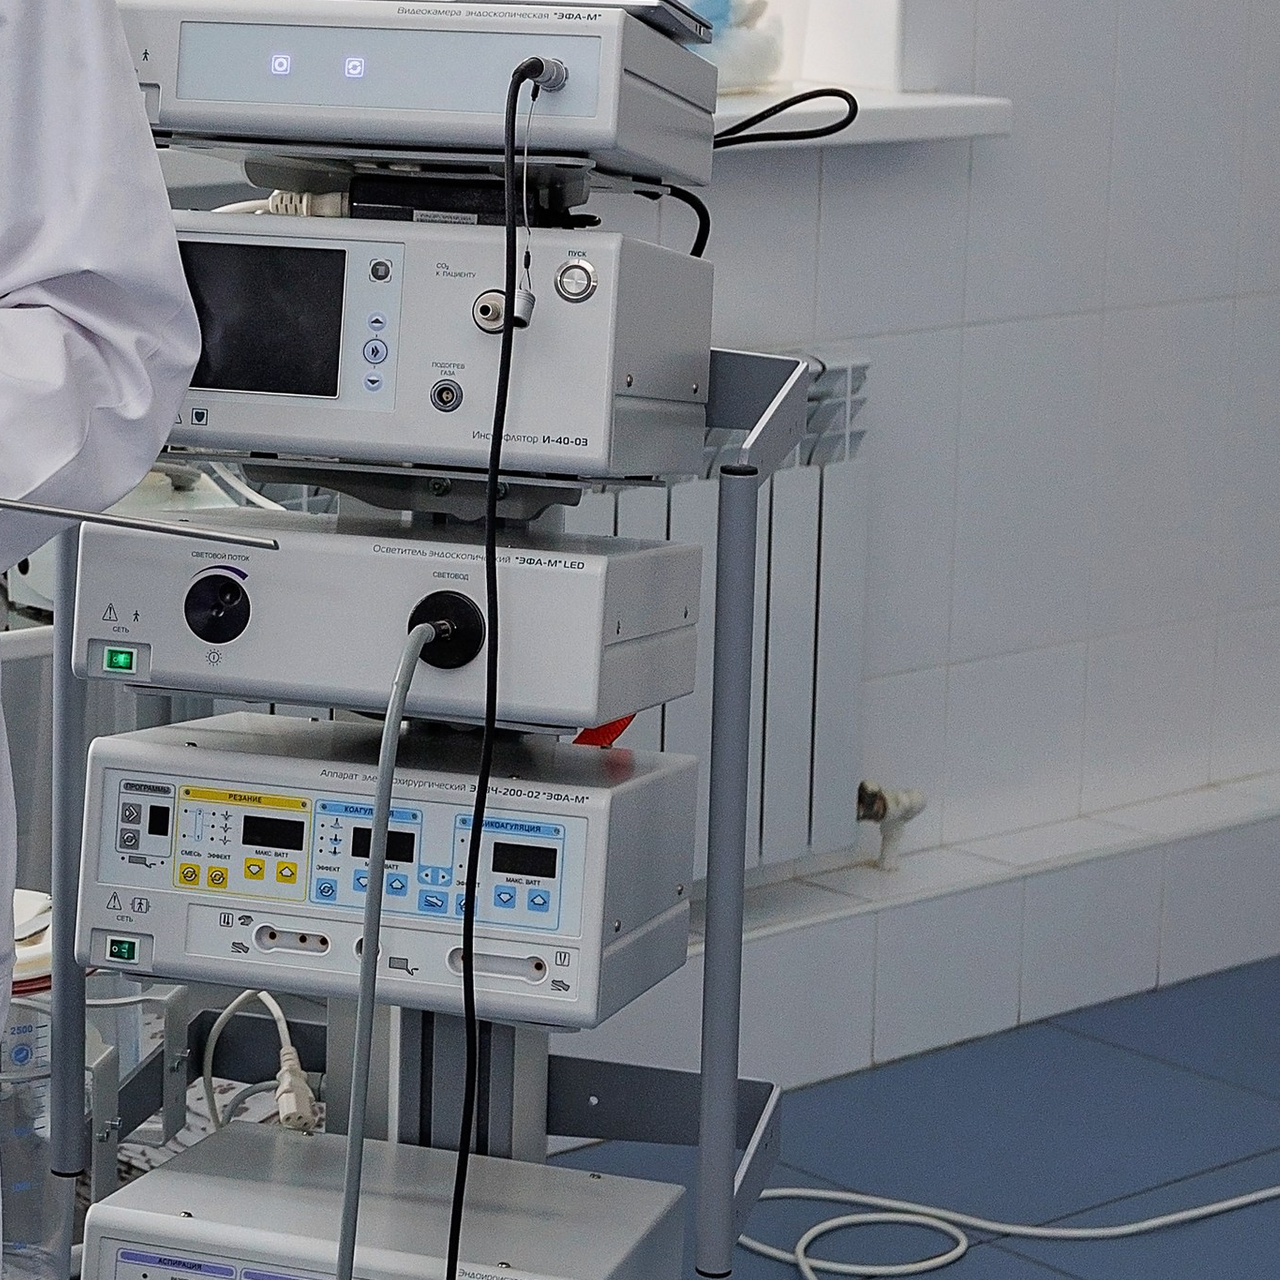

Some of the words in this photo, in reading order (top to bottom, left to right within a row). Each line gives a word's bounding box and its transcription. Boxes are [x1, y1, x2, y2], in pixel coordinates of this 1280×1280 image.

[397, 6, 462, 17] Видеокамера
[465, 11, 549, 20] эндоскопическая
[431, 362, 466, 370] ПОДОГРЕВ
[472, 431, 538, 444] Инсфлятор
[542, 435, 588, 447] И-40-03
[191, 551, 227, 560] СВЕТОВОЙ
[227, 554, 250, 562] ПОТОК
[372, 544, 428, 557] Осветитель
[563, 560, 585, 570] LED
[432, 571, 469, 581] СВЕТОВОД
[320, 769, 359, 781] Аппарат
[361, 773, 466, 792] элеохирургический
[124, 783, 170, 794] ПРОГРАММЫ
[228, 793, 262, 804] РЕЗАНИЕ
[344, 805, 395, 818] КОАГУЛЯ
[180, 849, 203, 858] СМЕСЬ
[207, 852, 231, 861] ЭФФЕКТ
[116, 915, 133, 923] СЕТЬ
[10, 1024, 33, 1035] 2500
[157, 1257, 202, 1270] АСПИРАЦИЯ
